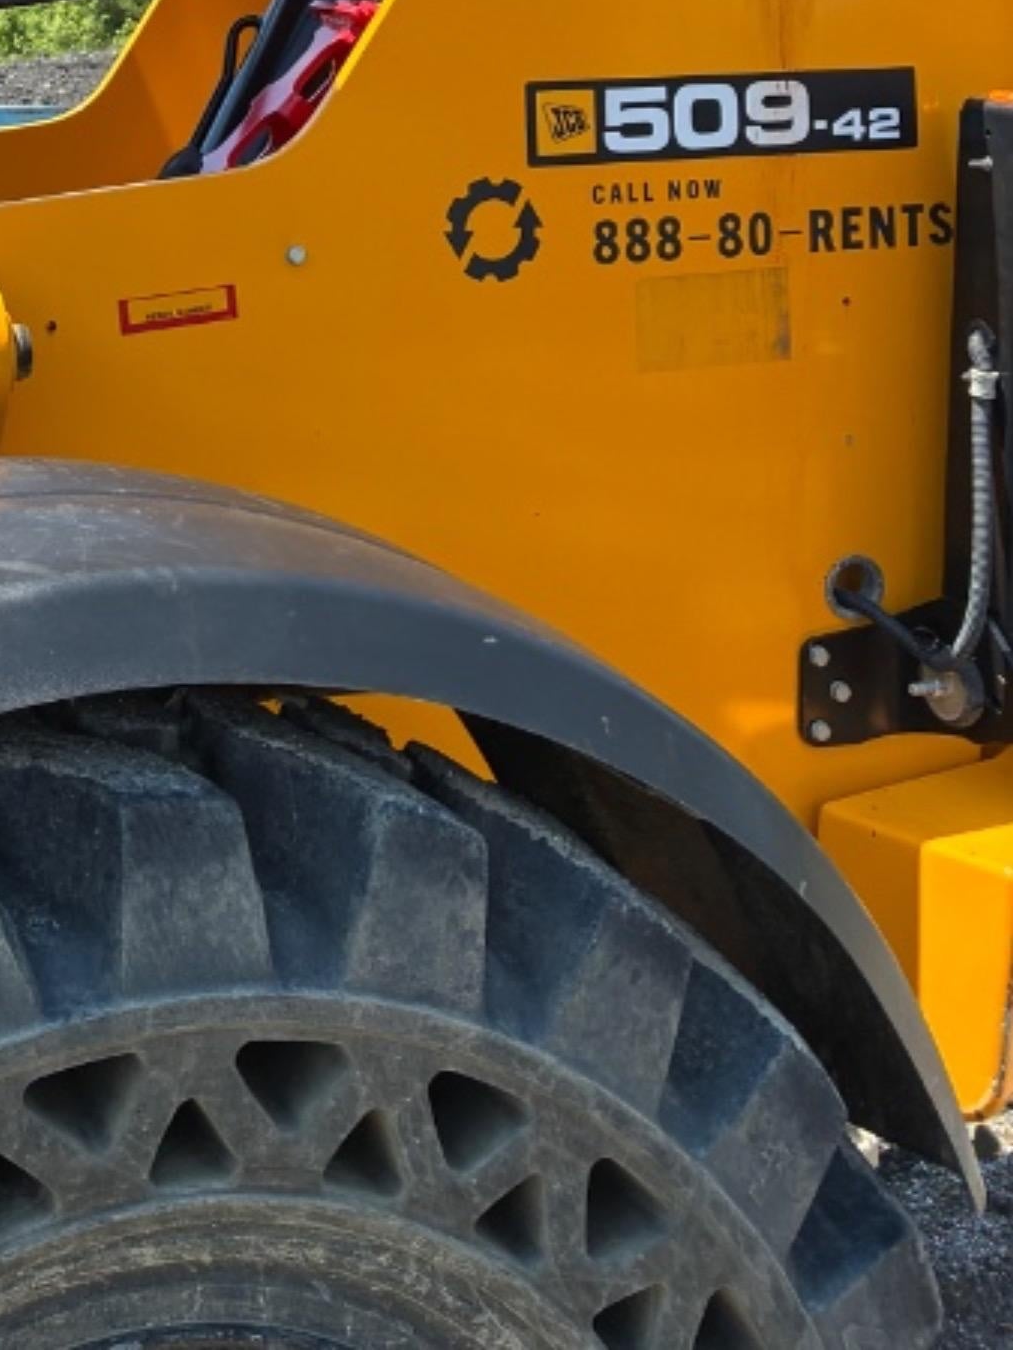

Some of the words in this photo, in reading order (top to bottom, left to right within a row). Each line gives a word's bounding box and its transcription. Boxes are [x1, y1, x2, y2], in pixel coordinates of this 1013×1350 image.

[603, 80, 901, 154] 509-42
[592, 182, 655, 204] CALL
[668, 179, 721, 200] NOW
[593, 202, 953, 264] 888-80-RENTS
